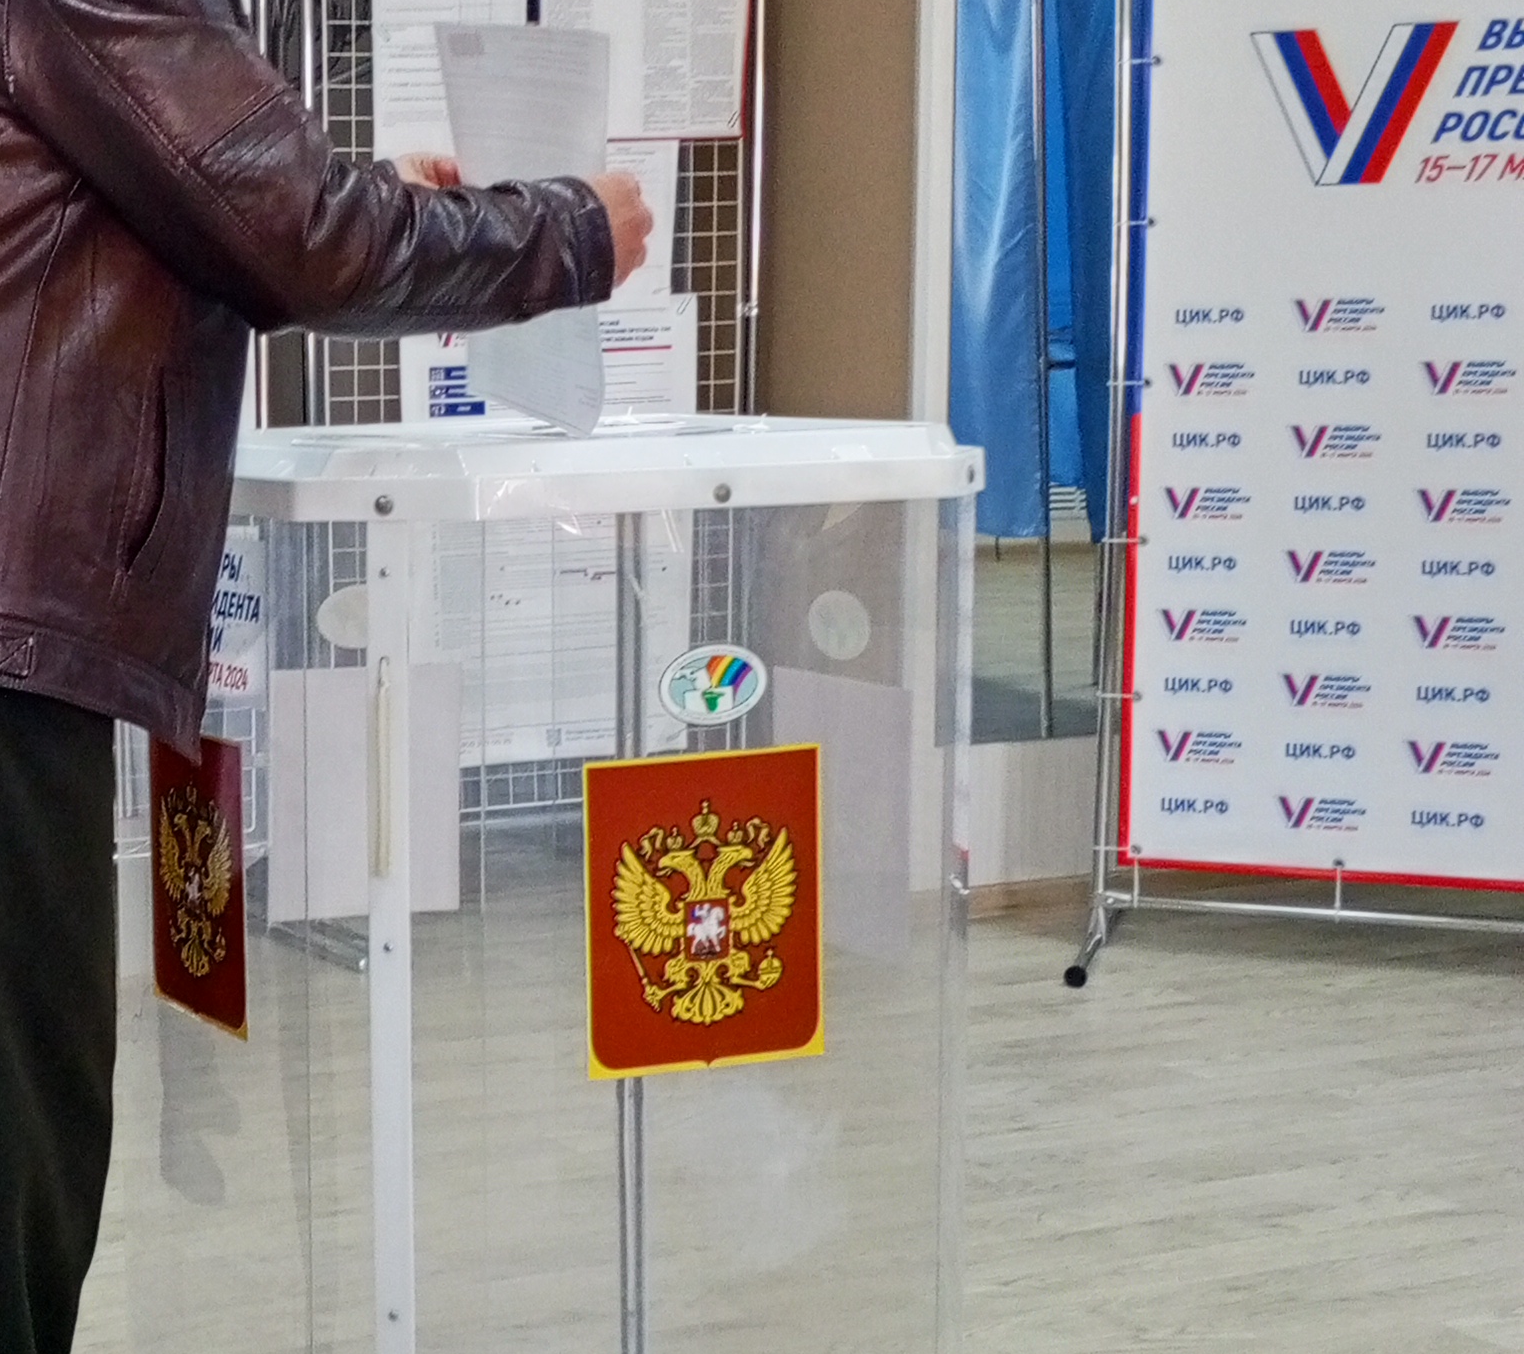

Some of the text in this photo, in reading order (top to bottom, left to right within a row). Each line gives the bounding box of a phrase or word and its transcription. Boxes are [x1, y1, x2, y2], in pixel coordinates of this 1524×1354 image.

[1175, 307, 1244, 326] ЦИК.РФ
[1430, 304, 1506, 323] ЦИК.РФ
[1299, 369, 1370, 387] ЦИК.РФ
[1172, 433, 1242, 451] ЦИК.РФ
[1426, 433, 1502, 452] ЦИК.РФ
[1294, 496, 1365, 514] ЦИК.РФ
[1168, 555, 1237, 573] ЦИК.РФ
[1422, 560, 1496, 579] ЦИК.РФ
[1290, 619, 1361, 638] ЦИК.РФ
[1164, 677, 1233, 695] ЦИК.РФ
[1416, 686, 1490, 706] ЦИК.РФ
[1286, 743, 1356, 761] ЦИК.РФ
[1161, 797, 1228, 817] ЦИК.РФ
[1411, 809, 1485, 830] ЦИК.РФ
